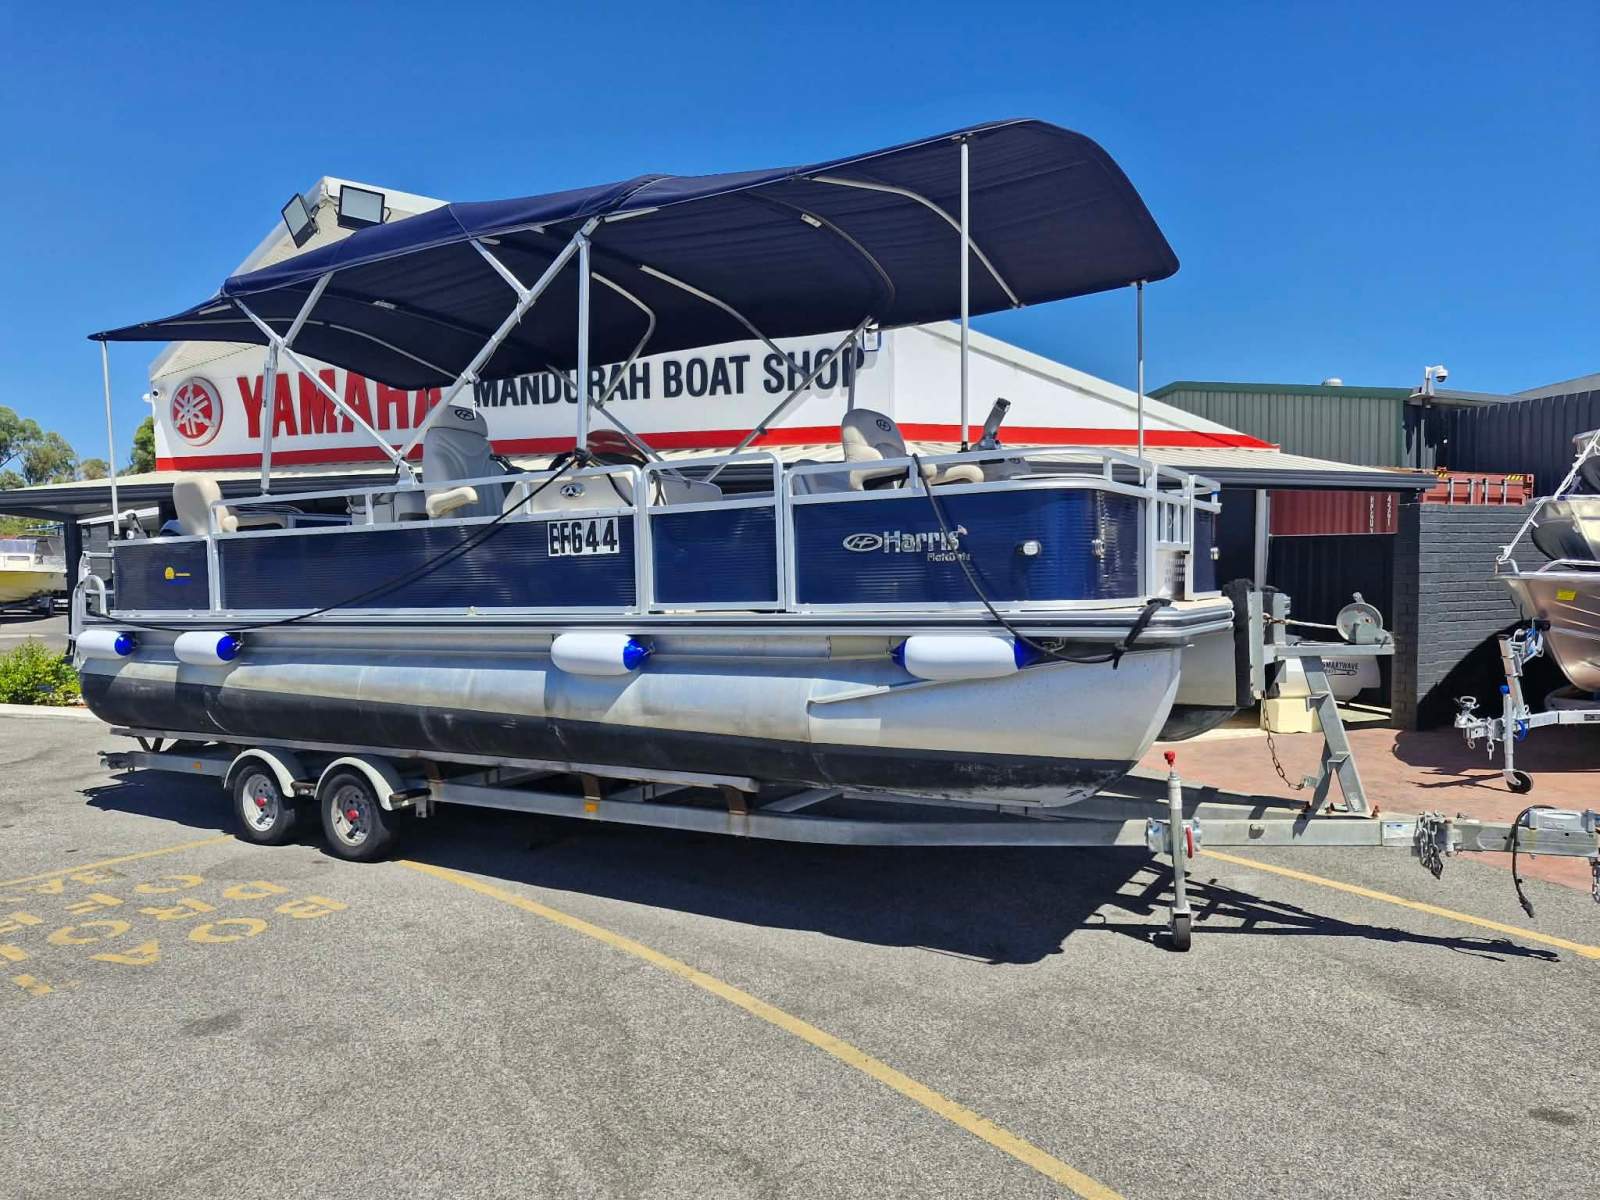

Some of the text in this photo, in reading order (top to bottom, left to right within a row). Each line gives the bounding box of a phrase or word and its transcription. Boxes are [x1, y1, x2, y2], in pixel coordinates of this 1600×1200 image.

[663, 355, 750, 398] BOAT
[763, 348, 864, 394] SHOP
[883, 529, 960, 553] Harris
